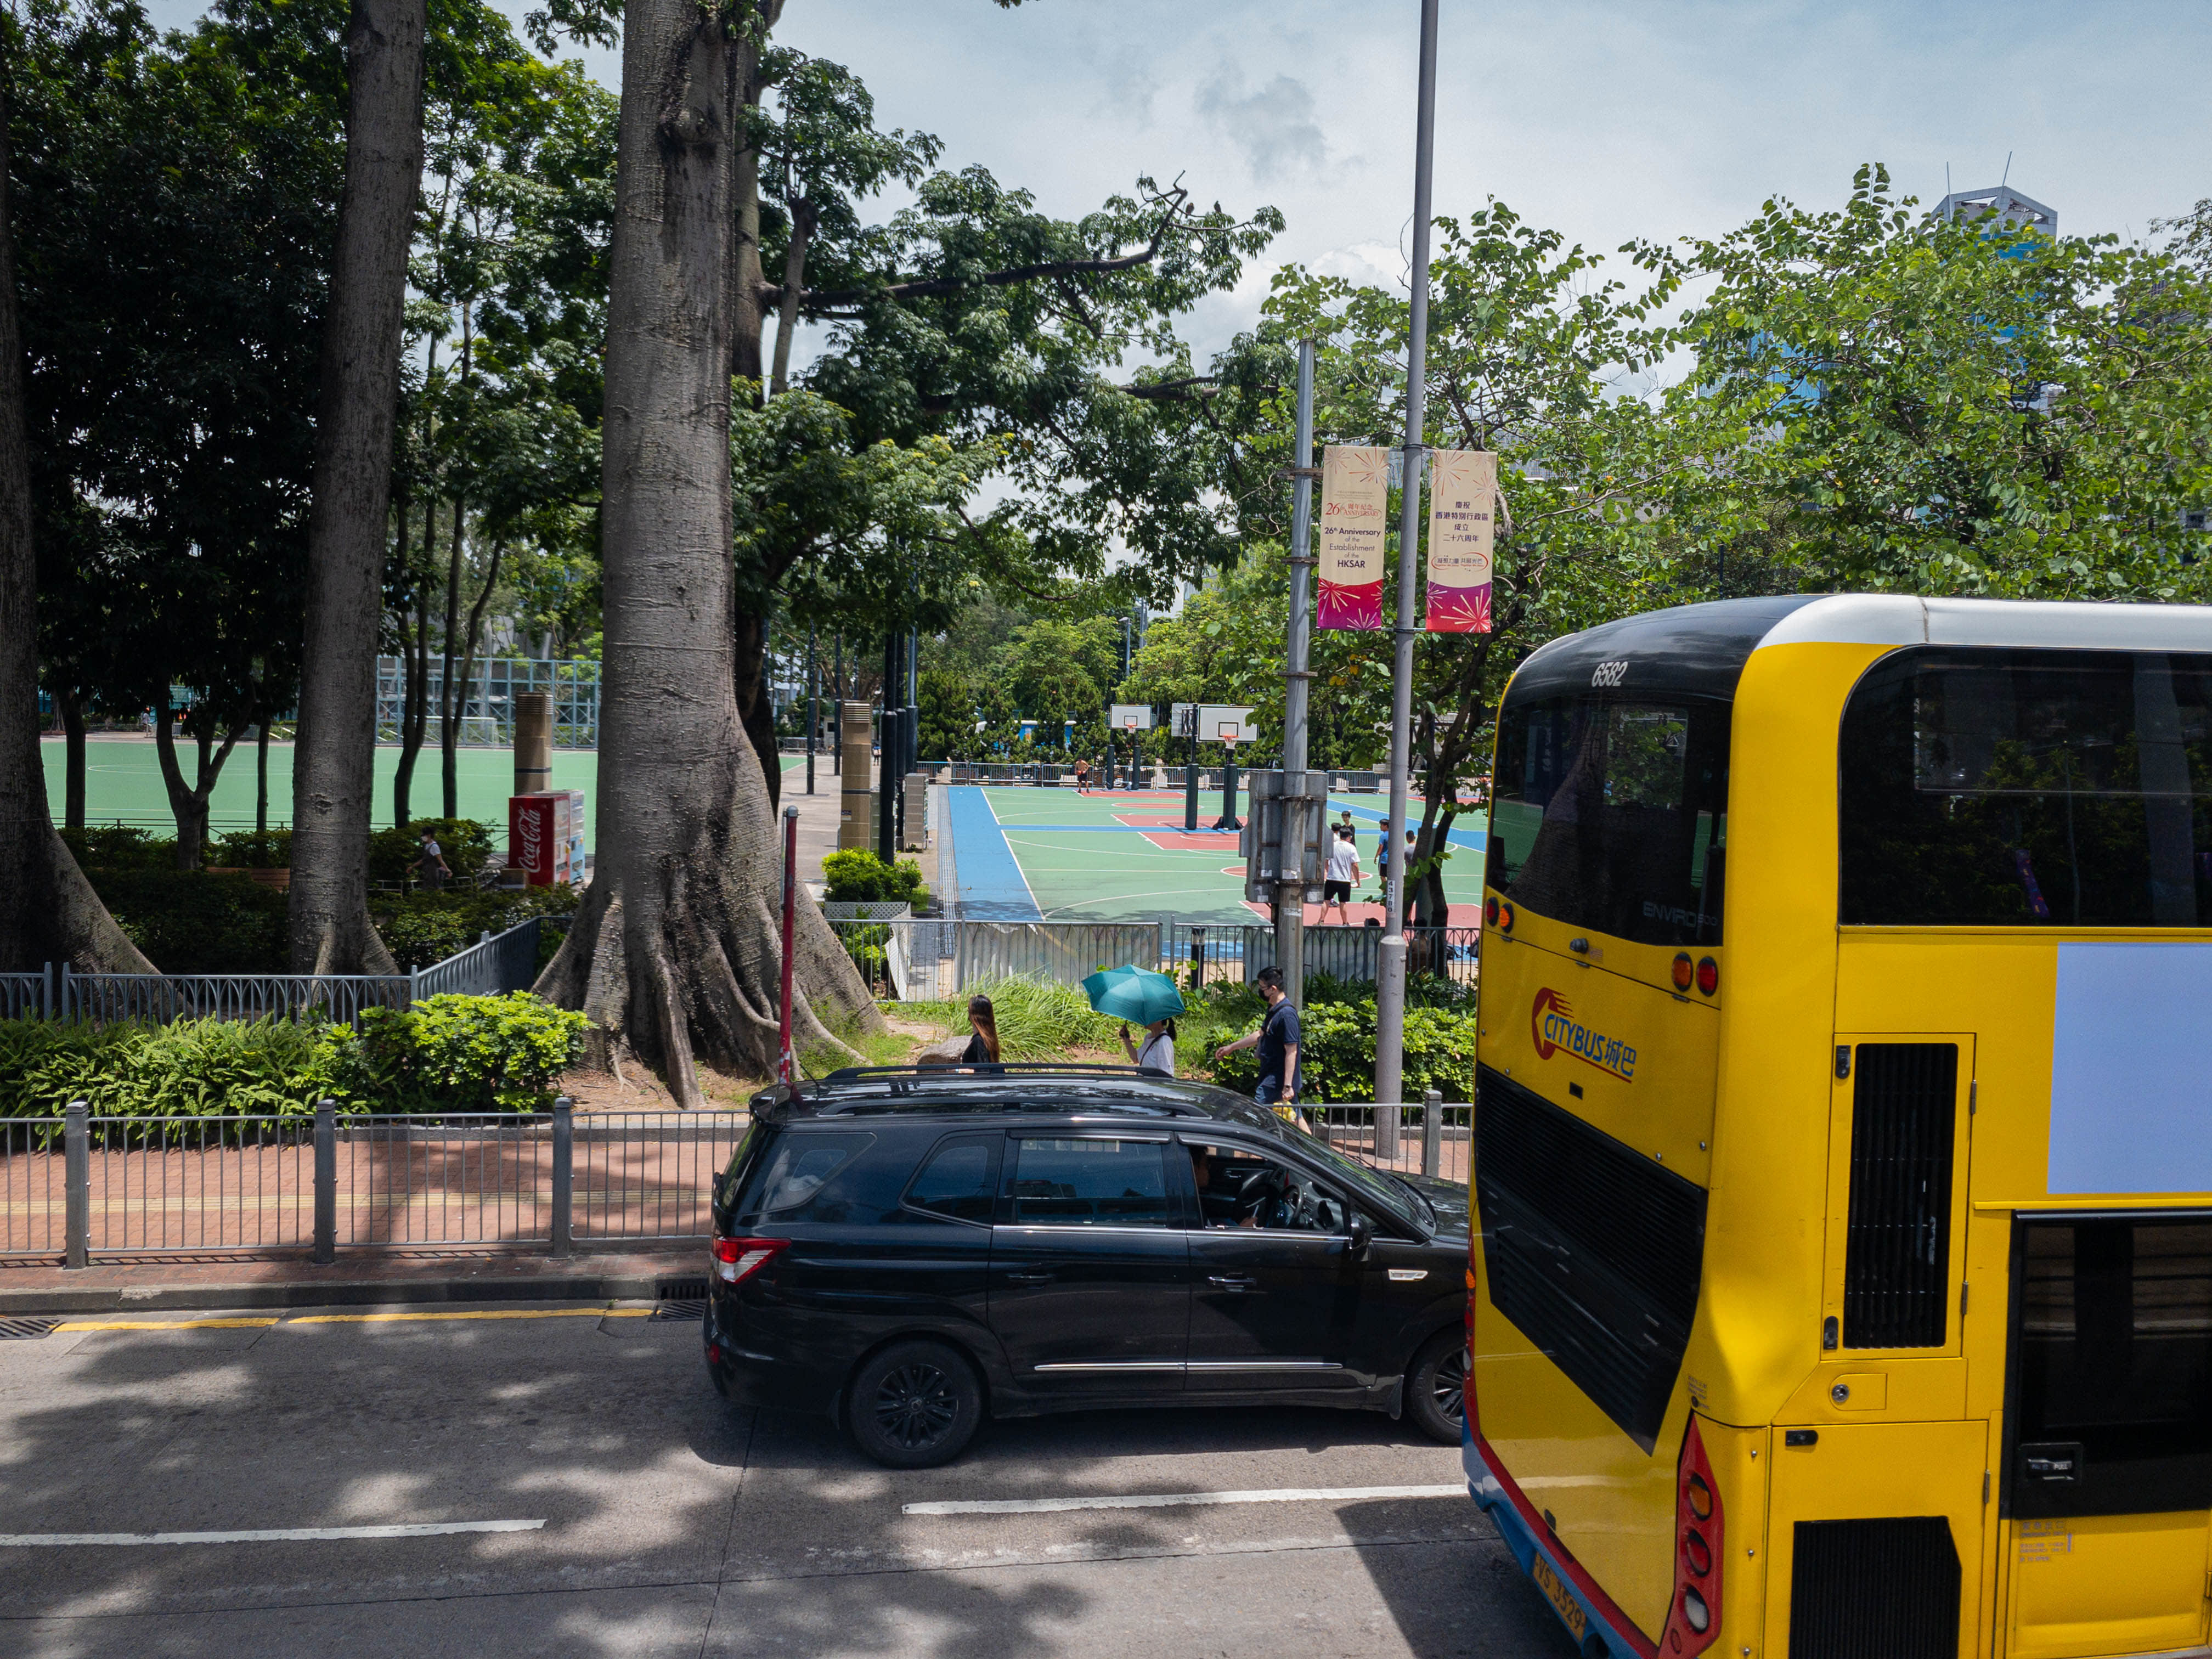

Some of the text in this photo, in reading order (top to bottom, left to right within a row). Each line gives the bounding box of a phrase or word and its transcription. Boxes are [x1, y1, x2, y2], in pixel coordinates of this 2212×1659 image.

[1435, 511, 1488, 521] 香港特別行政區
[1339, 527, 1381, 537] Anniversary
[1443, 534, 1480, 542] 二十六周年
[1329, 543, 1375, 551] Establishment
[1338, 560, 1365, 568] HKSAR
[1592, 661, 1628, 687] 6582
[1544, 1013, 1637, 1077] CITYBUS 城巴
